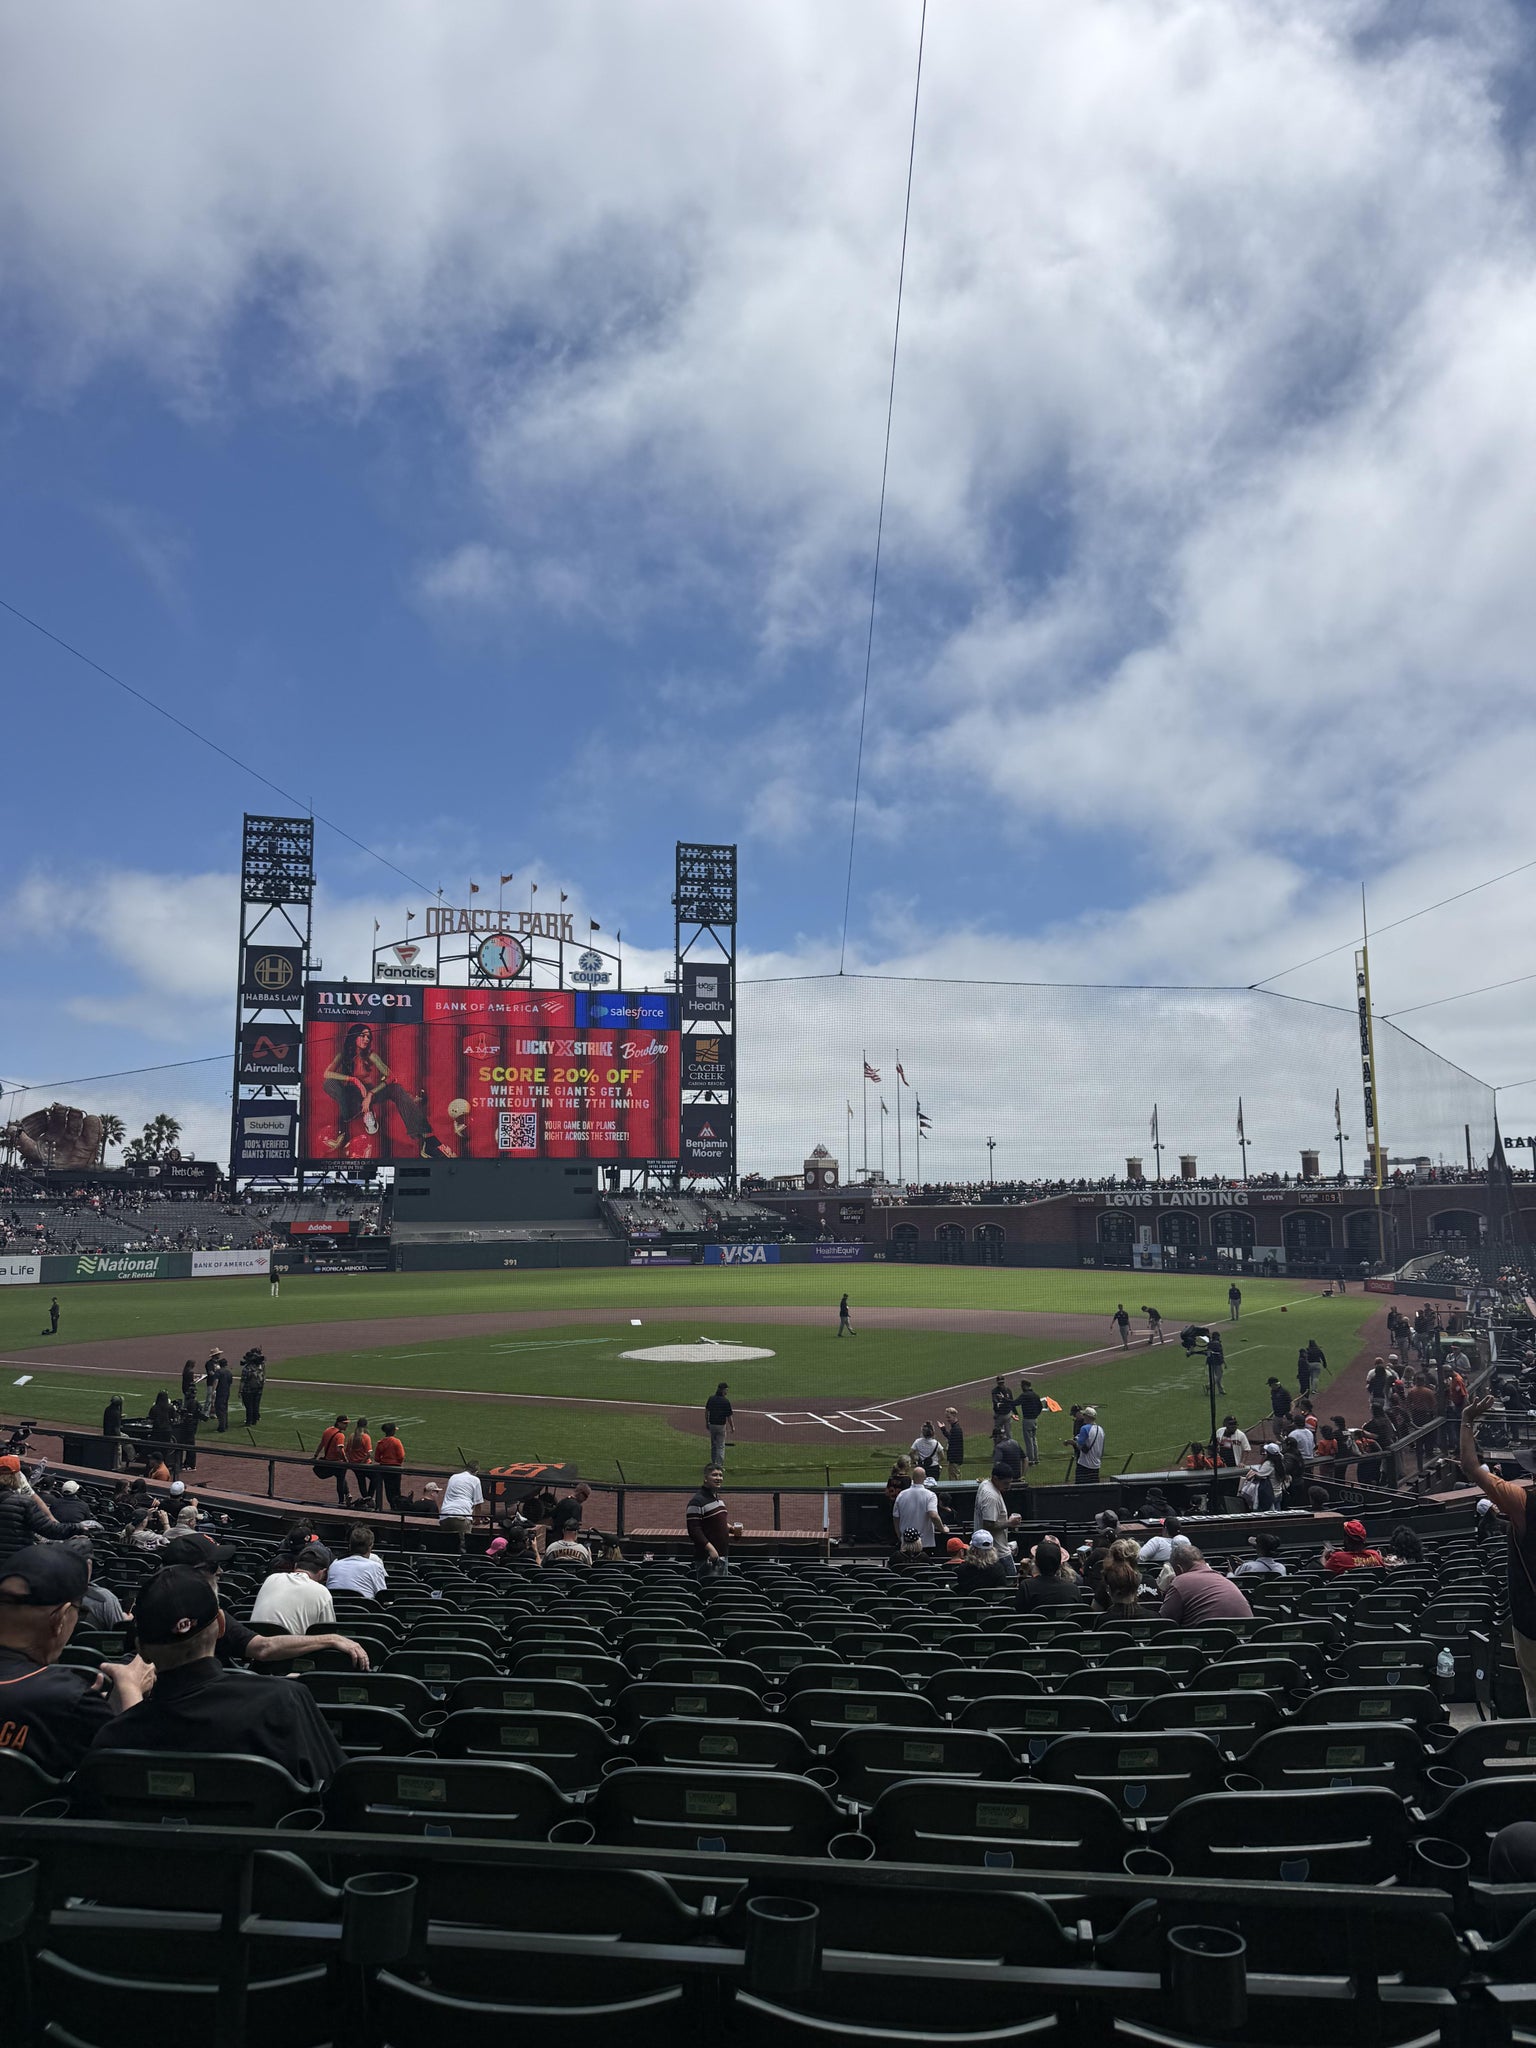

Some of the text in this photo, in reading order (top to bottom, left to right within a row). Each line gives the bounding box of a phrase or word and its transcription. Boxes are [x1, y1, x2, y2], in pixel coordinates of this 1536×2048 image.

[426, 907, 574, 942] ORACLE PARK
[376, 964, 436, 979] Fanatics
[573, 972, 610, 985] coupa
[246, 993, 300, 1002] HABBAS LAW
[318, 991, 413, 1008] nuveen
[435, 1001, 539, 1013] BANK OF AMERICA
[688, 1000, 725, 1011] Health
[341, 1008, 372, 1017] Company
[610, 1005, 664, 1020] salesforce
[463, 1045, 501, 1055] AMF
[515, 1040, 555, 1056] LUCKY
[574, 1041, 613, 1057] STRIKE
[620, 1038, 669, 1060] Bowlero
[244, 1063, 295, 1073] Airwallex
[688, 1063, 726, 1072] CACHE
[478, 1067, 644, 1084] SCORE 20% OFF
[689, 1072, 724, 1080] CREEK
[490, 1085, 633, 1097] WHEN THE GIANTS GET A
[472, 1097, 650, 1109] STRIKEOUT IN THE 7TH INNING
[249, 1121, 285, 1130] StubHub
[544, 1121, 616, 1130] YOUR GAME DAY PLANS
[544, 1132, 630, 1141] RIGHT ACROSS THE STREET!
[244, 1139, 289, 1149] 100% VERIFIED
[685, 1139, 728, 1149] Benjamin
[241, 1149, 291, 1159] GIANTS TICKETS
[692, 1149, 722, 1158] Moore
[186, 1167, 205, 1177] Coffee
[1159, 1192, 1249, 1206] LANDING
[1321, 1194, 1336, 1202] 109
[719, 1245, 767, 1263] VISA
[815, 1246, 860, 1255] HealthEquity
[97, 1256, 159, 1272] National
[193, 1261, 213, 1269] BANK
[224, 1260, 254, 1268] AMERICA
[503, 1258, 518, 1266] 391
[10, 1265, 35, 1276] Life
[131, 1271, 156, 1279] Rental
